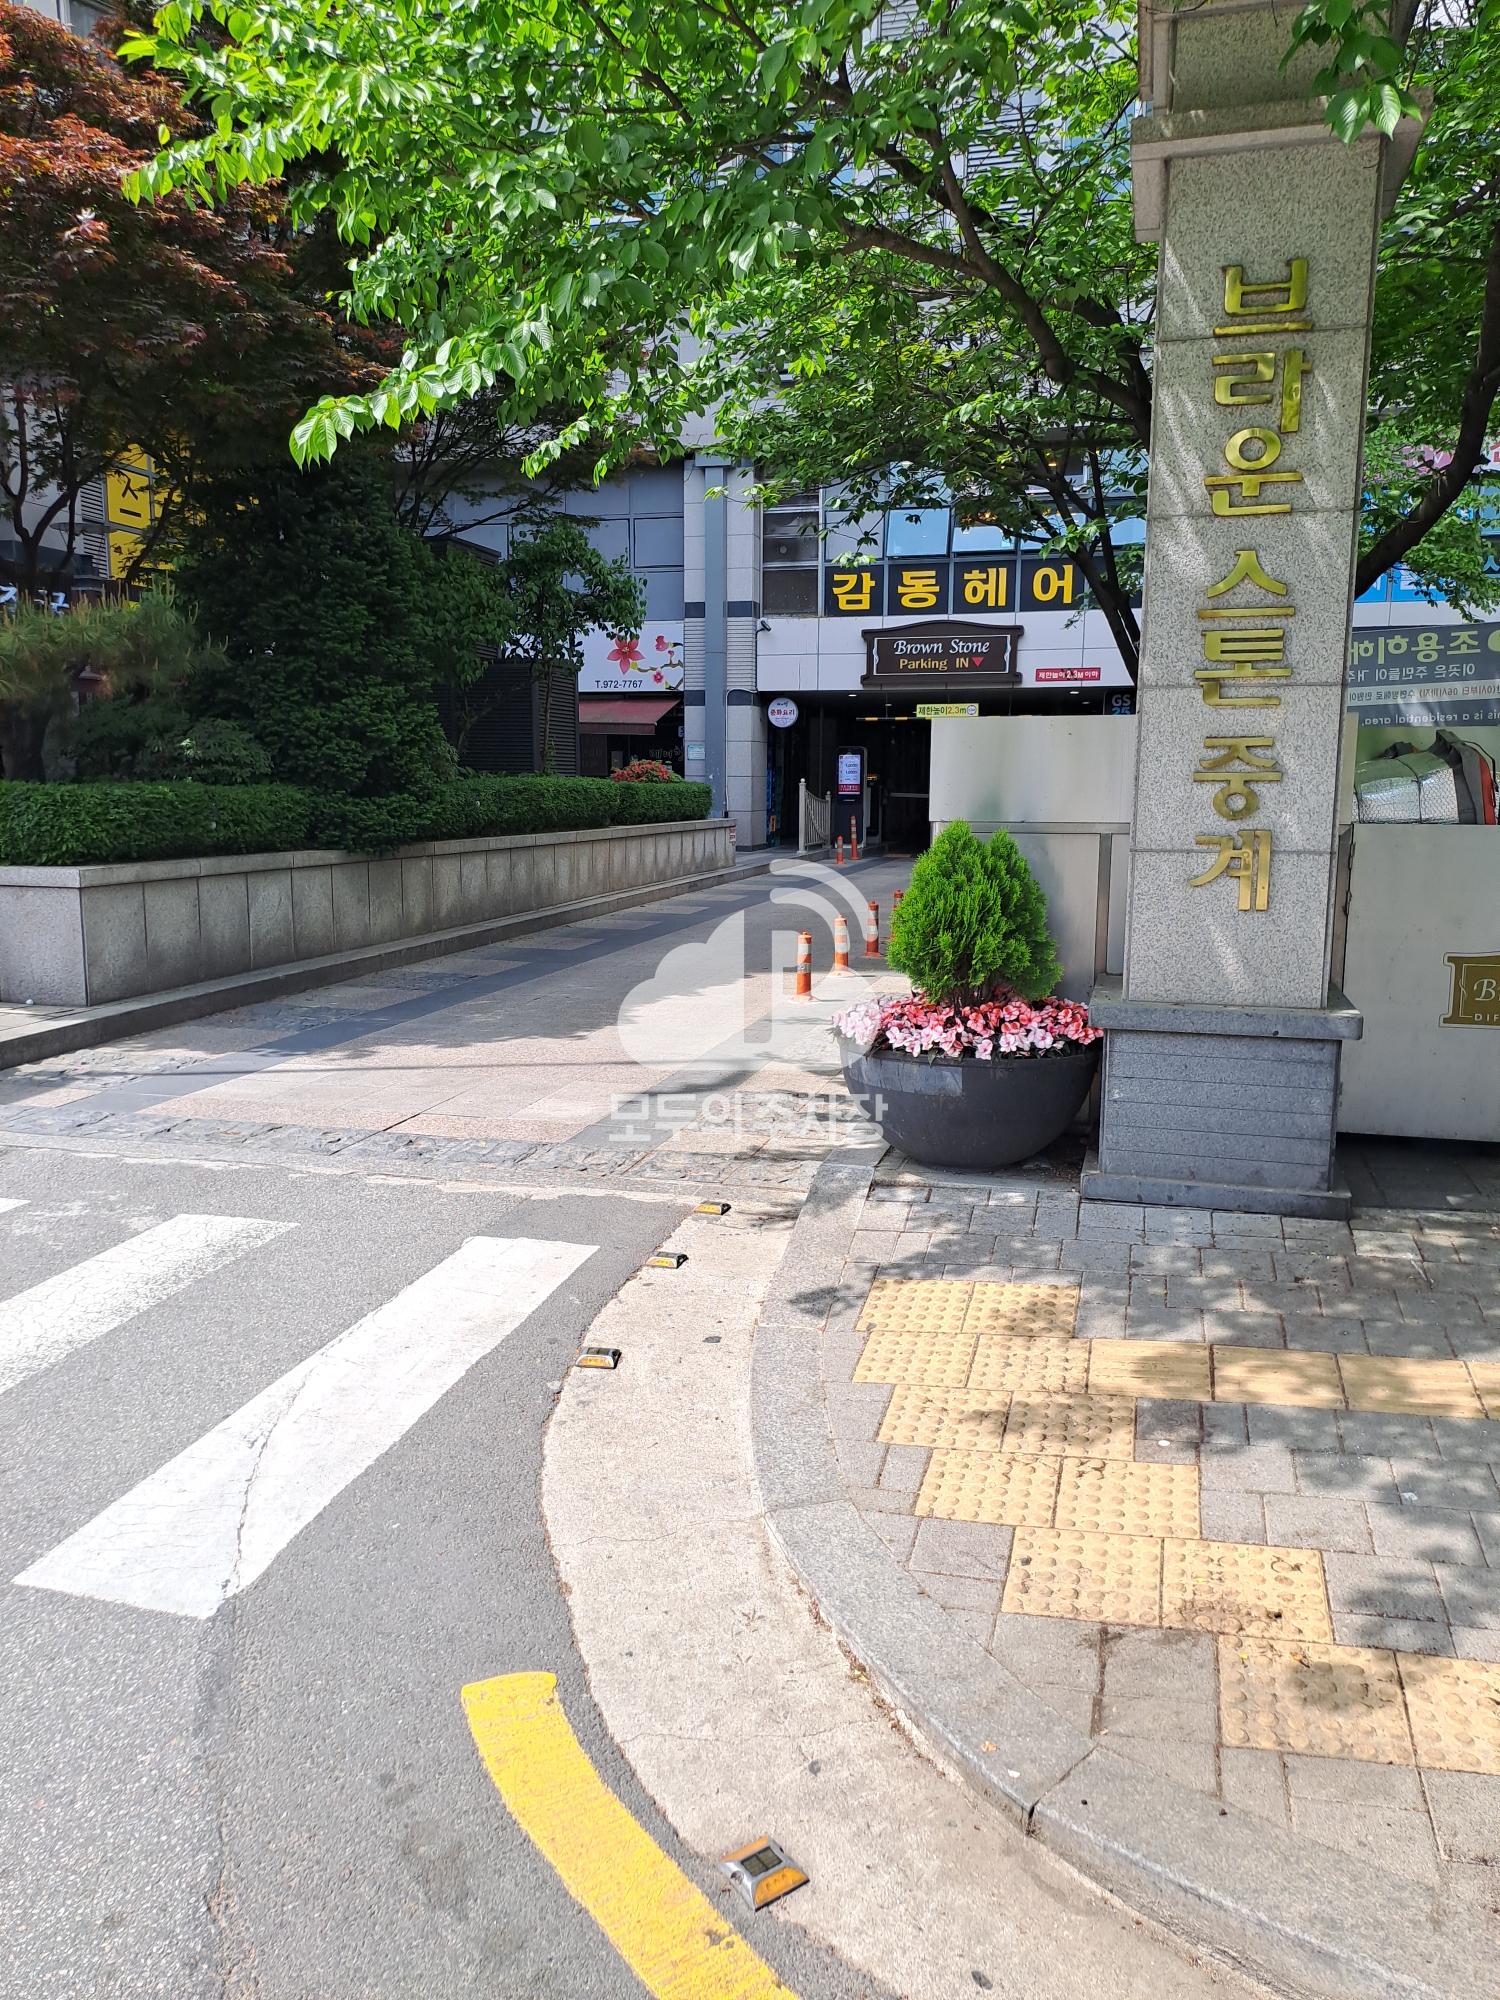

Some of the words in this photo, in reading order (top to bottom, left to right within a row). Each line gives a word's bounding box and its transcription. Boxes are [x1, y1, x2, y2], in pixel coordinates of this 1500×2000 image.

[893, 639, 943, 655] Brown
[950, 638, 990, 654] Stone
[899, 658, 948, 671] Parking
[955, 657, 969, 669] IN
[594, 680, 643, 689] T.972-7767
[1112, 694, 1131, 707] GS
